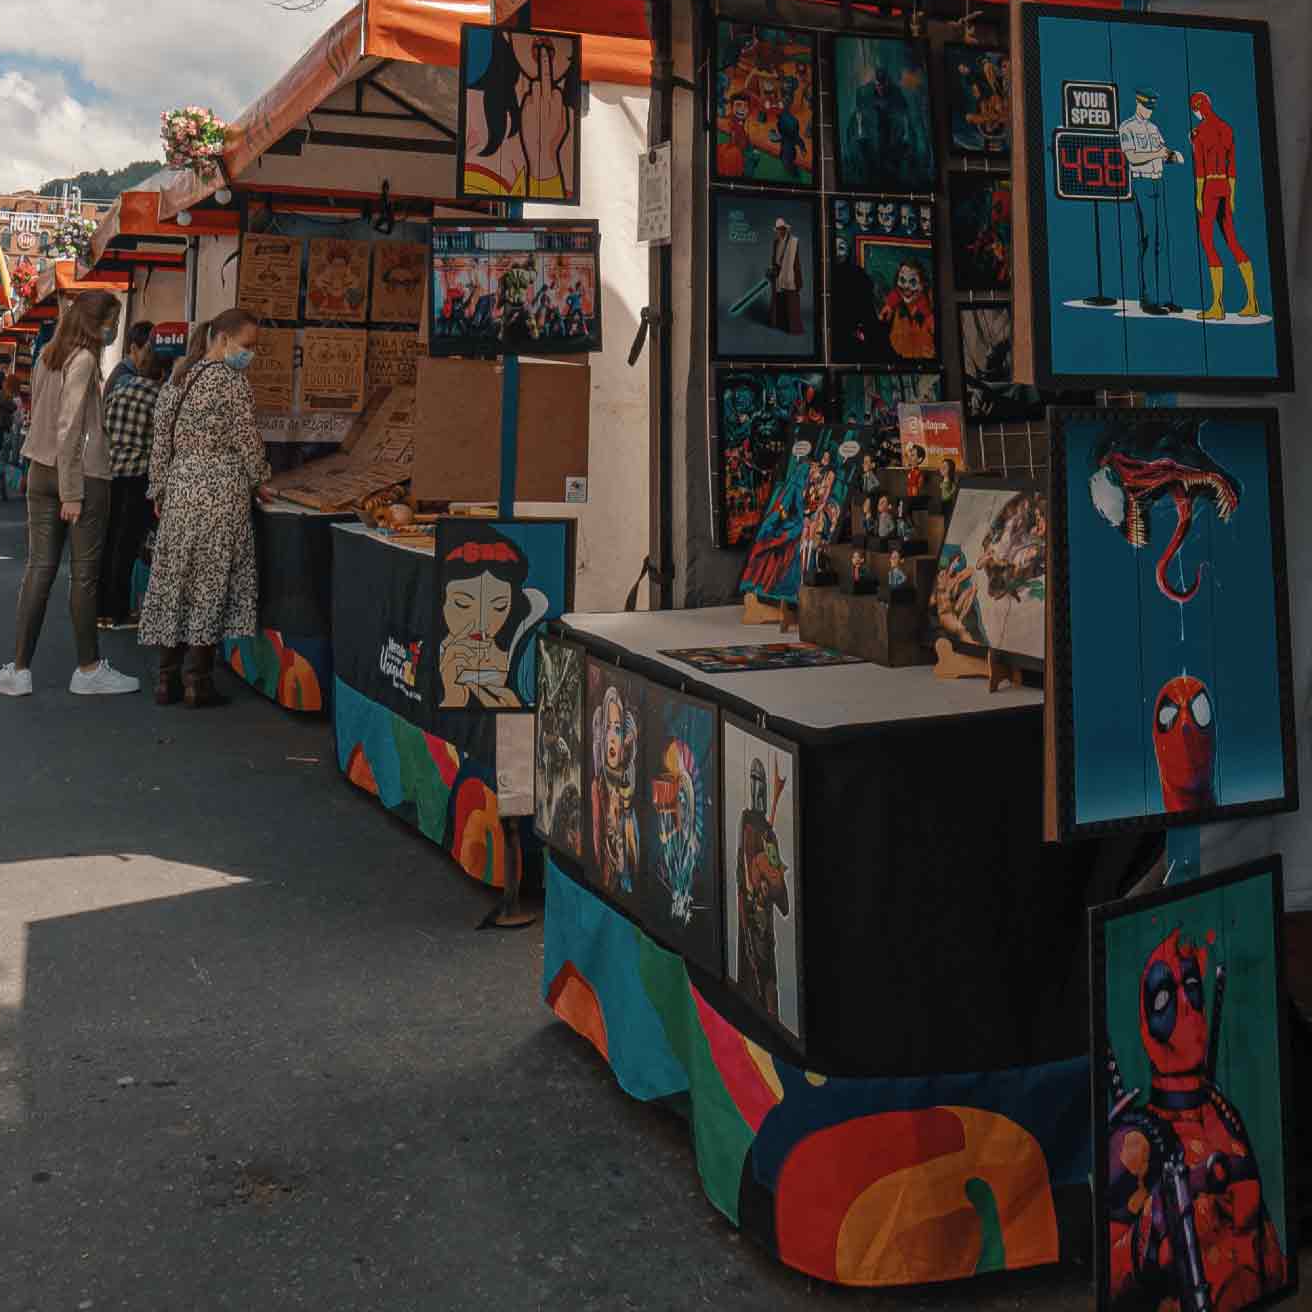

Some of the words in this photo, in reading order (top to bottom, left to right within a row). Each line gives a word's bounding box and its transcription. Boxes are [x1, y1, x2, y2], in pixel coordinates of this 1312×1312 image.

[1073, 91, 1107, 108] YOUR
[1071, 109, 1111, 125] SPEED
[1061, 145, 1128, 188] 458
[10, 215, 41, 233] HOTEL
